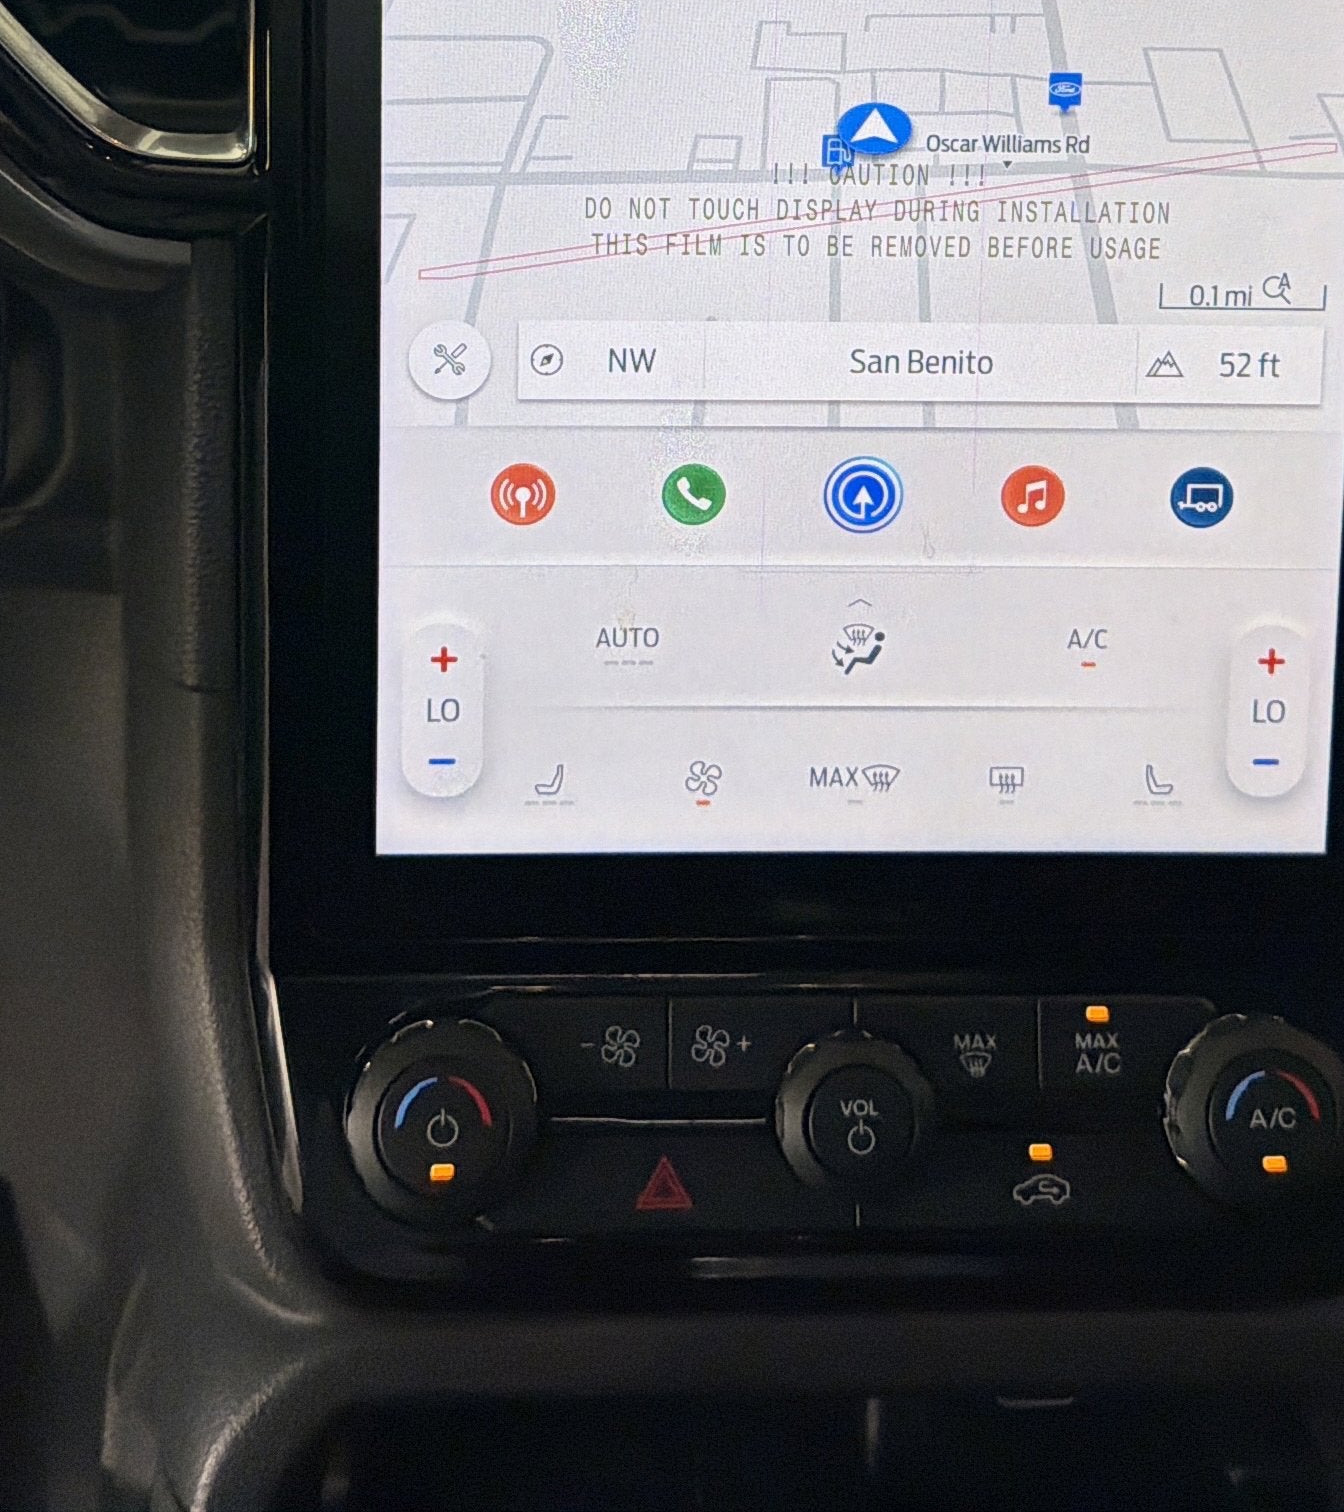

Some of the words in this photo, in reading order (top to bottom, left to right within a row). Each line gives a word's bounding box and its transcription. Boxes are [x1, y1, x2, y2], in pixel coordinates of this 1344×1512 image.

[926, 135, 978, 153] Oscar
[982, 135, 1061, 153] Williams
[1066, 136, 1090, 153] Rd
[829, 163, 929, 186] CAUTION
[585, 197, 612, 219] DO
[629, 197, 671, 219] NOT
[688, 198, 759, 220] TOUCH
[777, 199, 877, 222] DISPLAY
[894, 200, 979, 223] DURING
[997, 201, 1170, 224] INSTALLATION
[592, 233, 648, 255] THIS
[666, 234, 721, 256] FILM
[741, 234, 765, 256] IS
[783, 235, 810, 256] TO
[827, 235, 853, 257] BE
[871, 236, 970, 257] REMOVED
[988, 236, 1073, 258] BEFORE
[1090, 237, 1161, 259] USAGE
[1189, 285, 1219, 307] 0.1
[1225, 285, 1253, 306] mi
[608, 349, 656, 374] NW
[850, 349, 900, 375] San
[907, 349, 993, 376] Benito
[1219, 352, 1252, 378] 52
[1260, 351, 1281, 378] ft
[596, 627, 660, 649] AUTO
[1067, 628, 1108, 651] A/C
[426, 699, 460, 723] LO
[1252, 699, 1286, 724] LO
[809, 767, 858, 788] MAX
[954, 1034, 997, 1050] MAX
[1075, 1033, 1118, 1049] MAX
[1076, 1053, 1121, 1074] A/C
[840, 1100, 879, 1116] VOL
[1249, 1107, 1296, 1130] A/C
